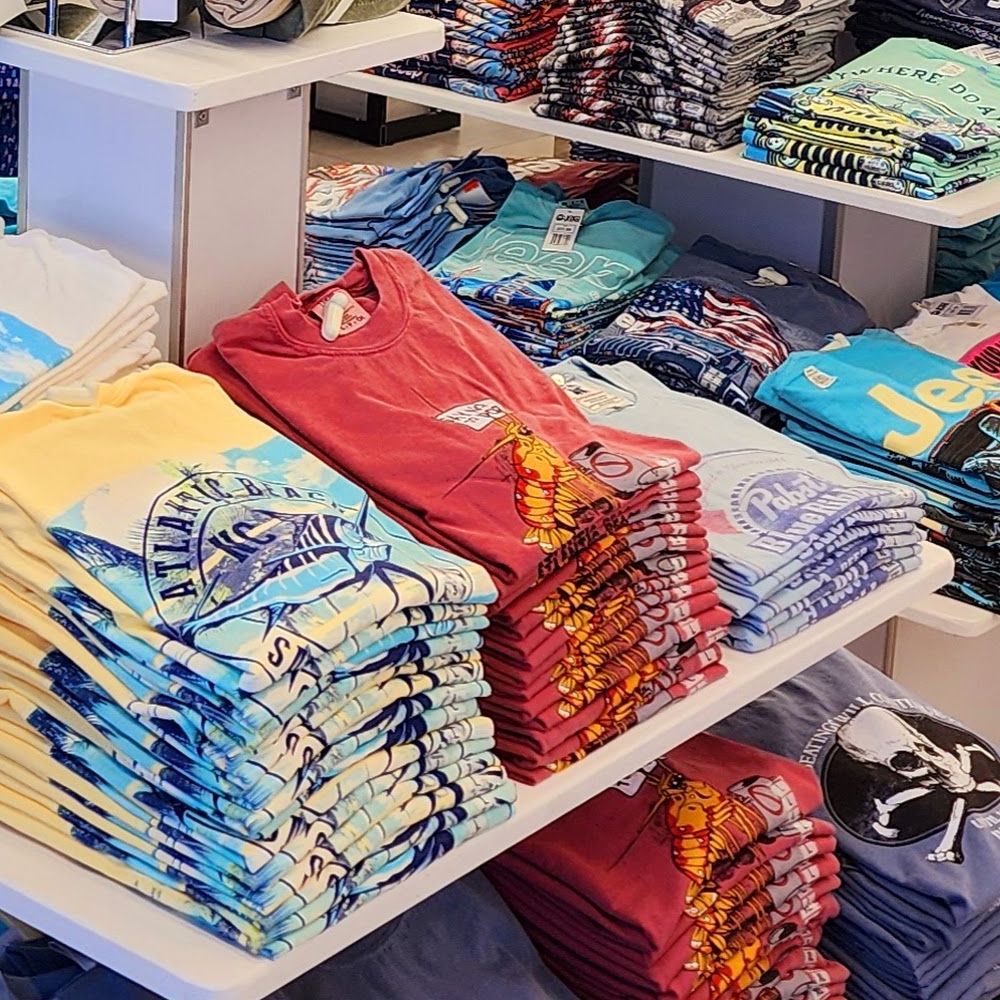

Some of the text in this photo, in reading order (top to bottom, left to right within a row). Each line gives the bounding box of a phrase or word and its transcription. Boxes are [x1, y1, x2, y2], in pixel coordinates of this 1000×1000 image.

[948, 82, 981, 105] DO
[867, 366, 1000, 458] Jee
[751, 472, 827, 522] Pabst
[153, 477, 234, 602] ATLANTIC
[208, 522, 278, 564] NC
[748, 505, 826, 556] Blue
